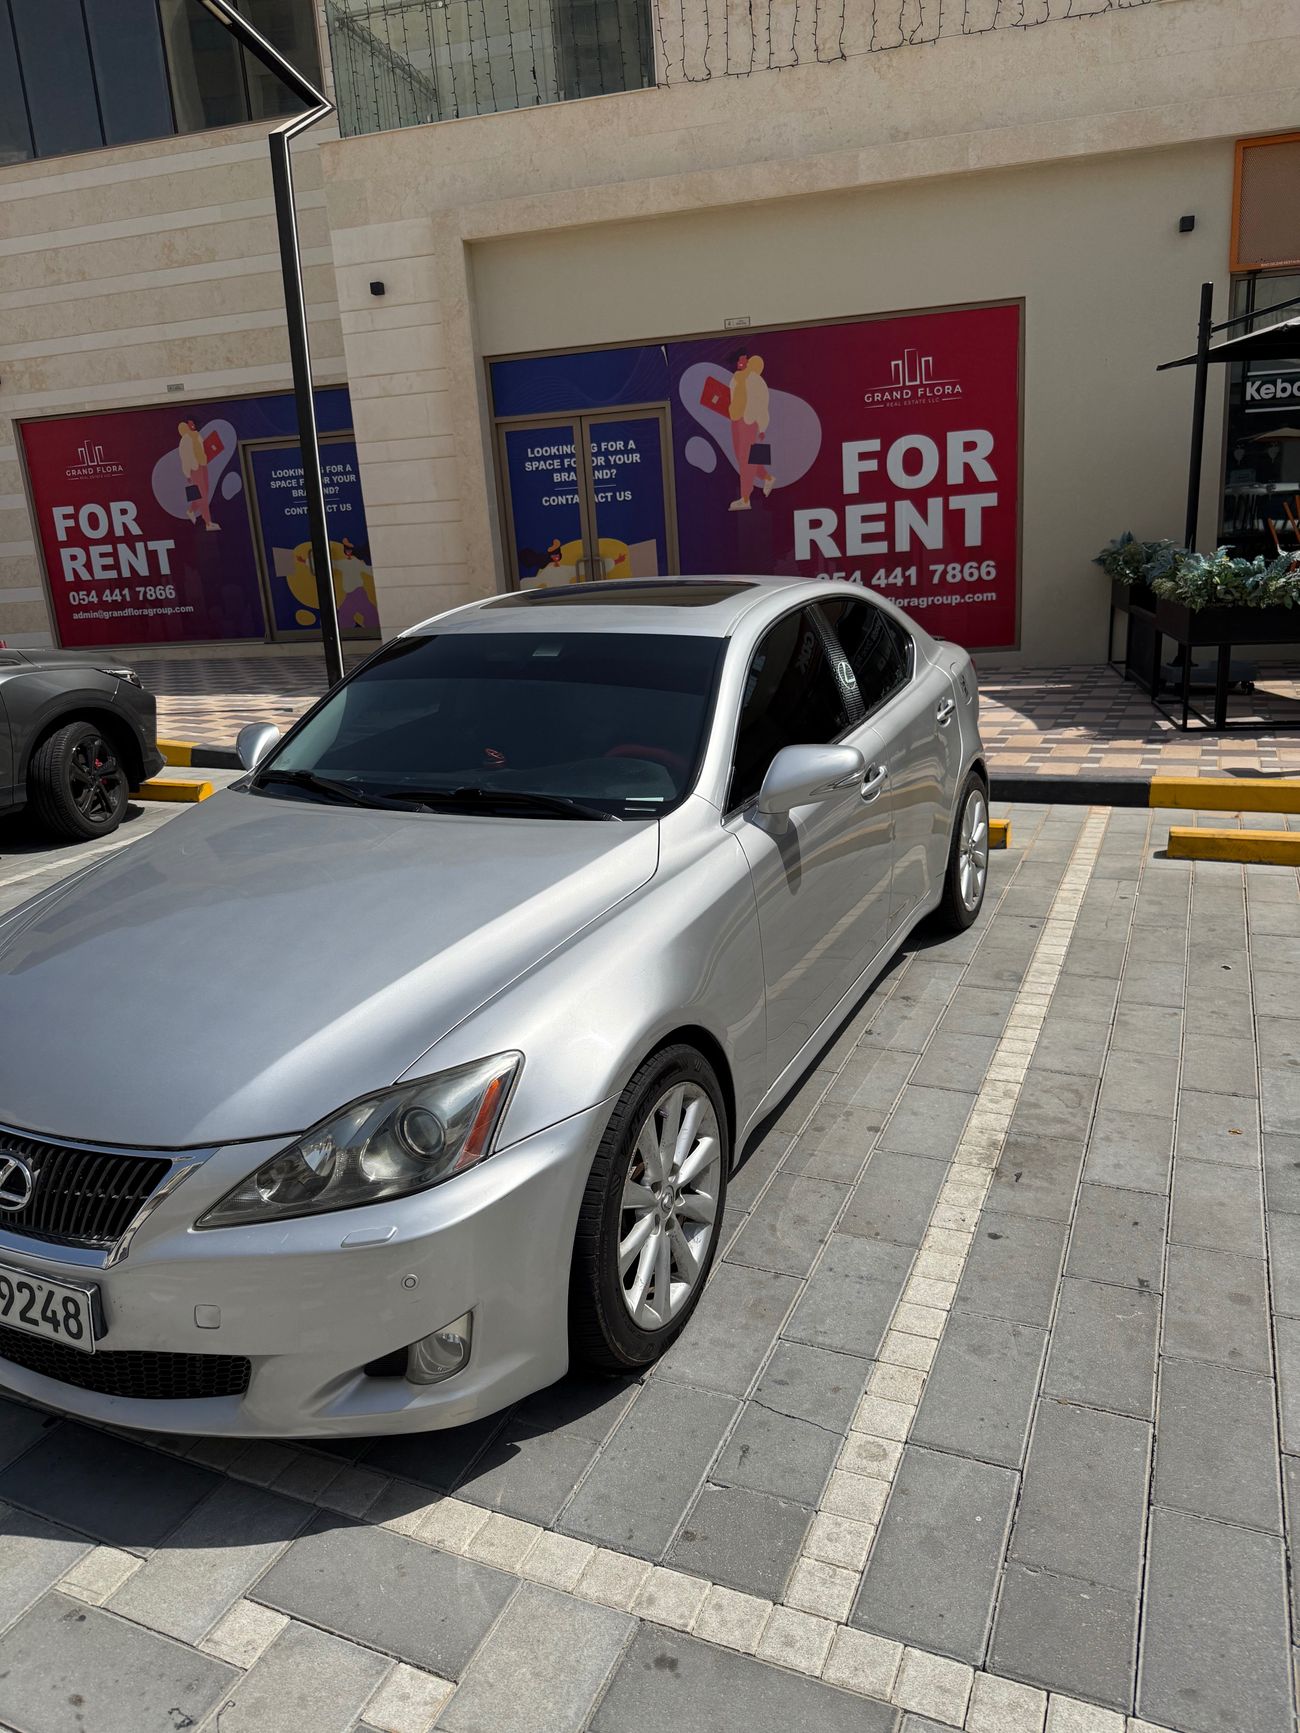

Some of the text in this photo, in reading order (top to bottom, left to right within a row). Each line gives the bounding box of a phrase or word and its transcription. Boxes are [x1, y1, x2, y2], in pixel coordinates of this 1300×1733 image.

[864, 384, 962, 403] GRAND FLORA
[601, 441, 625, 452] FOR
[627, 440, 636, 450] A
[65, 467, 94, 477] GRAND
[97, 464, 124, 474] FLORA
[326, 464, 344, 474] FOR
[346, 464, 352, 472] A
[525, 459, 561, 471] SPACE
[608, 453, 641, 465] YOUR
[842, 429, 998, 495] FOR
[270, 474, 356, 489] SPACE FR YOUR
[616, 491, 632, 501] US
[284, 503, 352, 515] CONTCT US
[52, 501, 143, 541] FOR
[793, 492, 998, 561] RENT
[60, 539, 175, 582] RENT
[871, 566, 917, 588] 441
[929, 560, 997, 584] 7866
[69, 584, 176, 605] 054 441 7866
[888, 592, 997, 609] loragroup.com
[73, 605, 194, 620] admin@grandfloragroup.com
[0, 1275, 84, 1341] 9248
